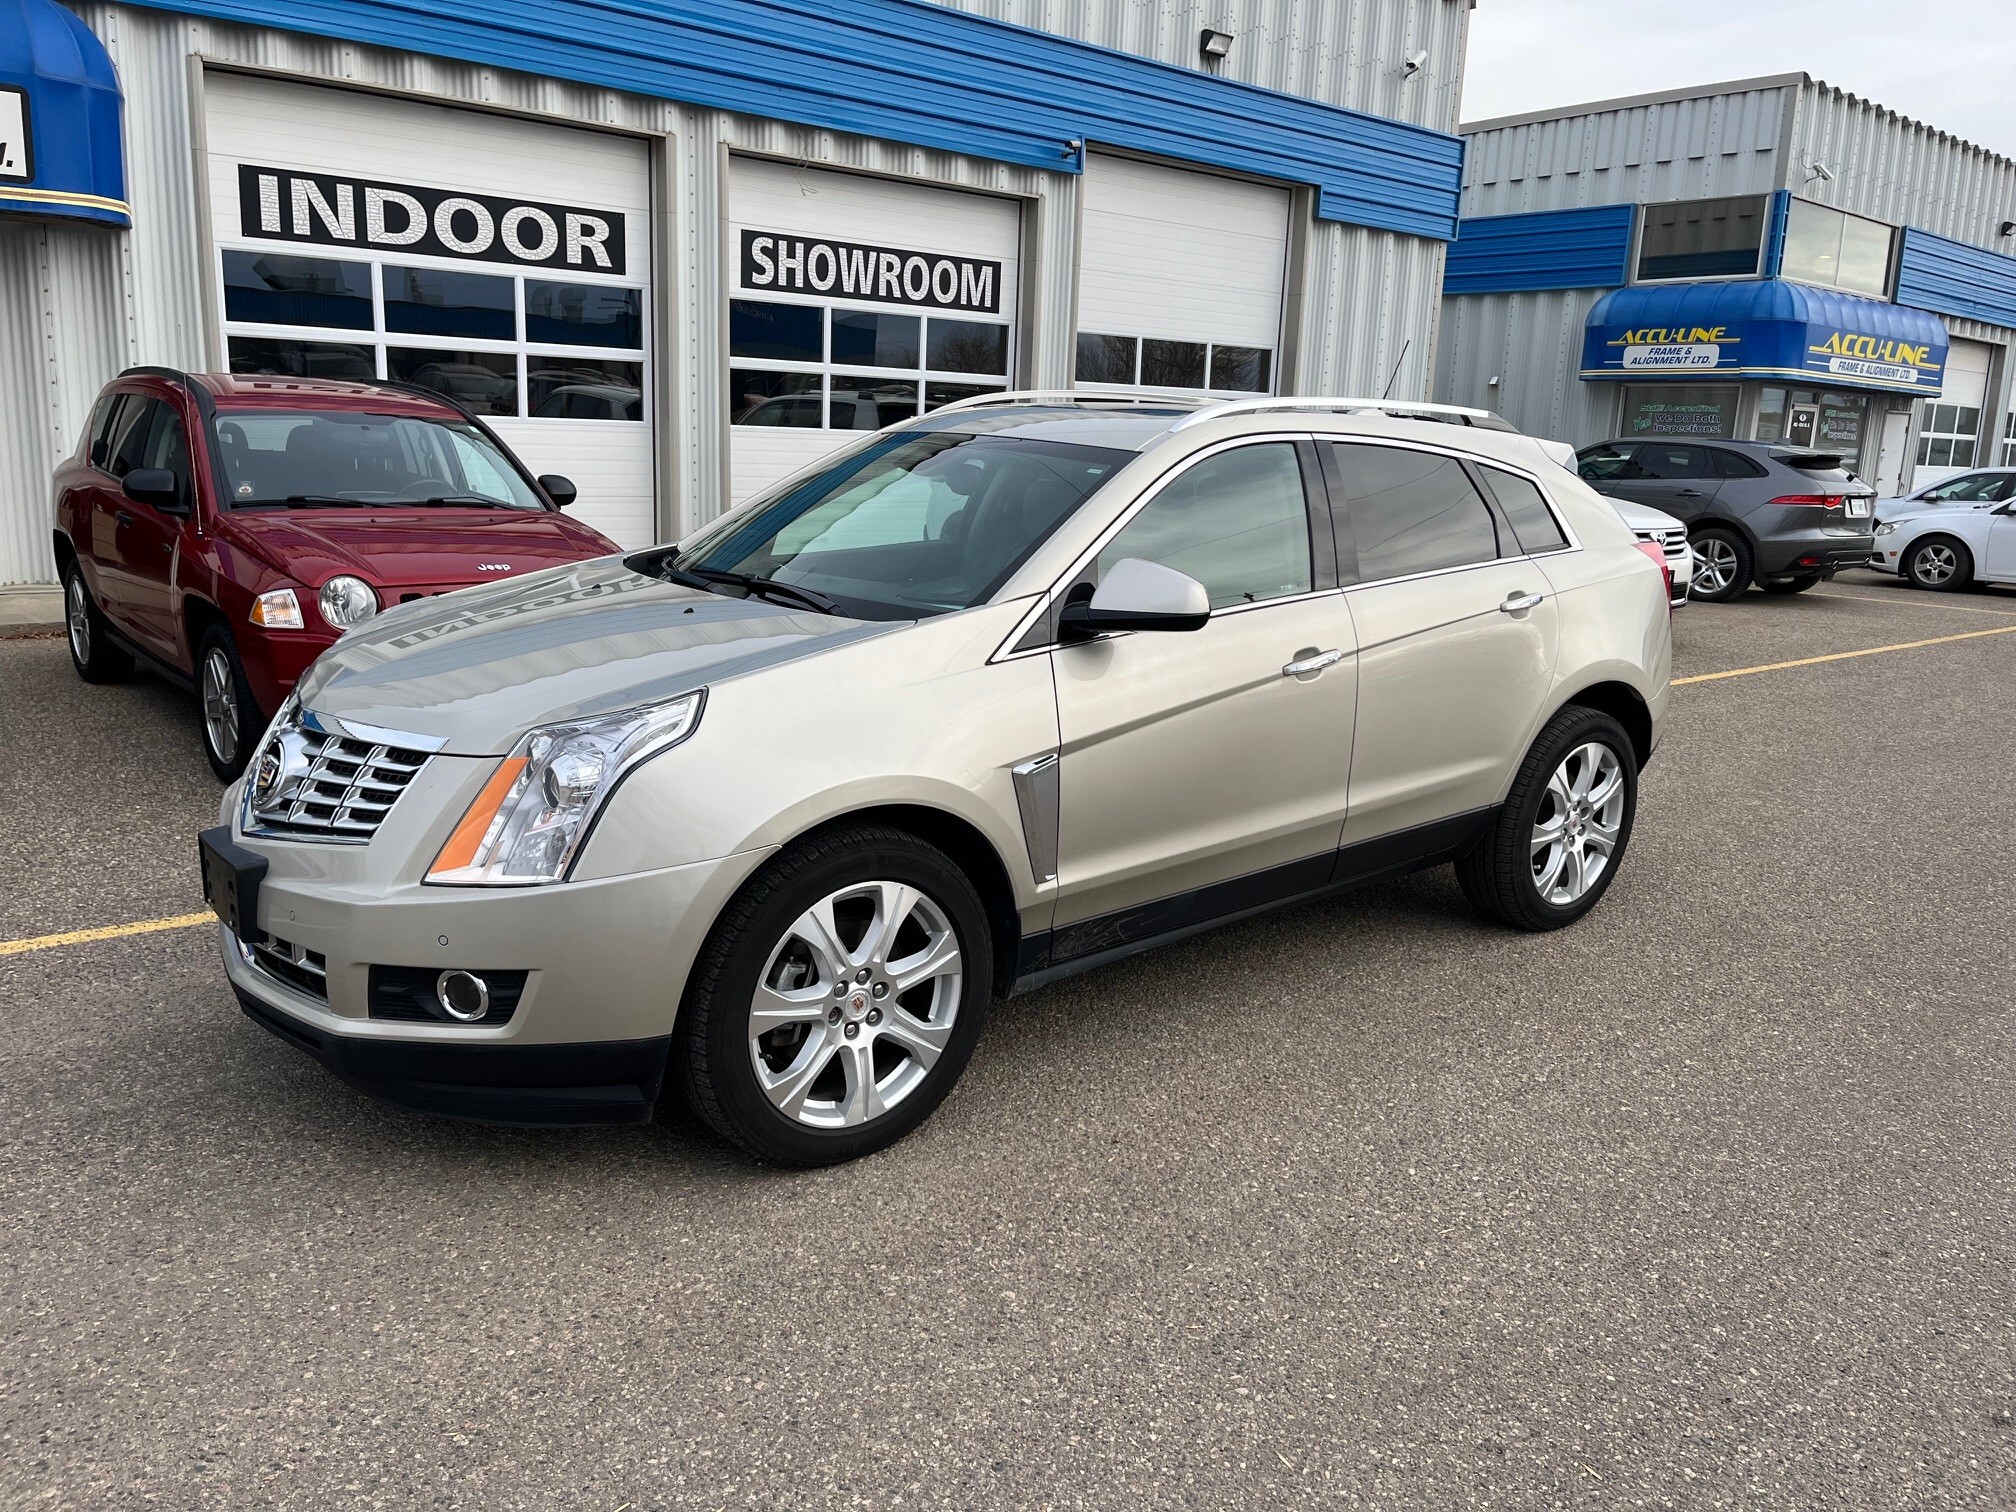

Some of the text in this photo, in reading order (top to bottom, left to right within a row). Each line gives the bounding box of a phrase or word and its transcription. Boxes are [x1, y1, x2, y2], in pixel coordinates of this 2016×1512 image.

[258, 173, 612, 268] INDOOR
[751, 236, 993, 308] SHOWROOM
[1607, 327, 1741, 344] ACCU-LINE
[1648, 347, 1693, 355] FRAME &
[1809, 332, 1941, 369] ACCU-LINE
[1630, 355, 1711, 365] ALIGNMENT LTD.
[1837, 361, 1859, 373] FRAME
[1859, 364, 1866, 373] &
[1866, 364, 1900, 379] ALIGNMENT
[1655, 413, 1720, 424] We Do Both
[1653, 423, 1722, 434] Inspections!
[477, 563, 511, 571] Jeep
